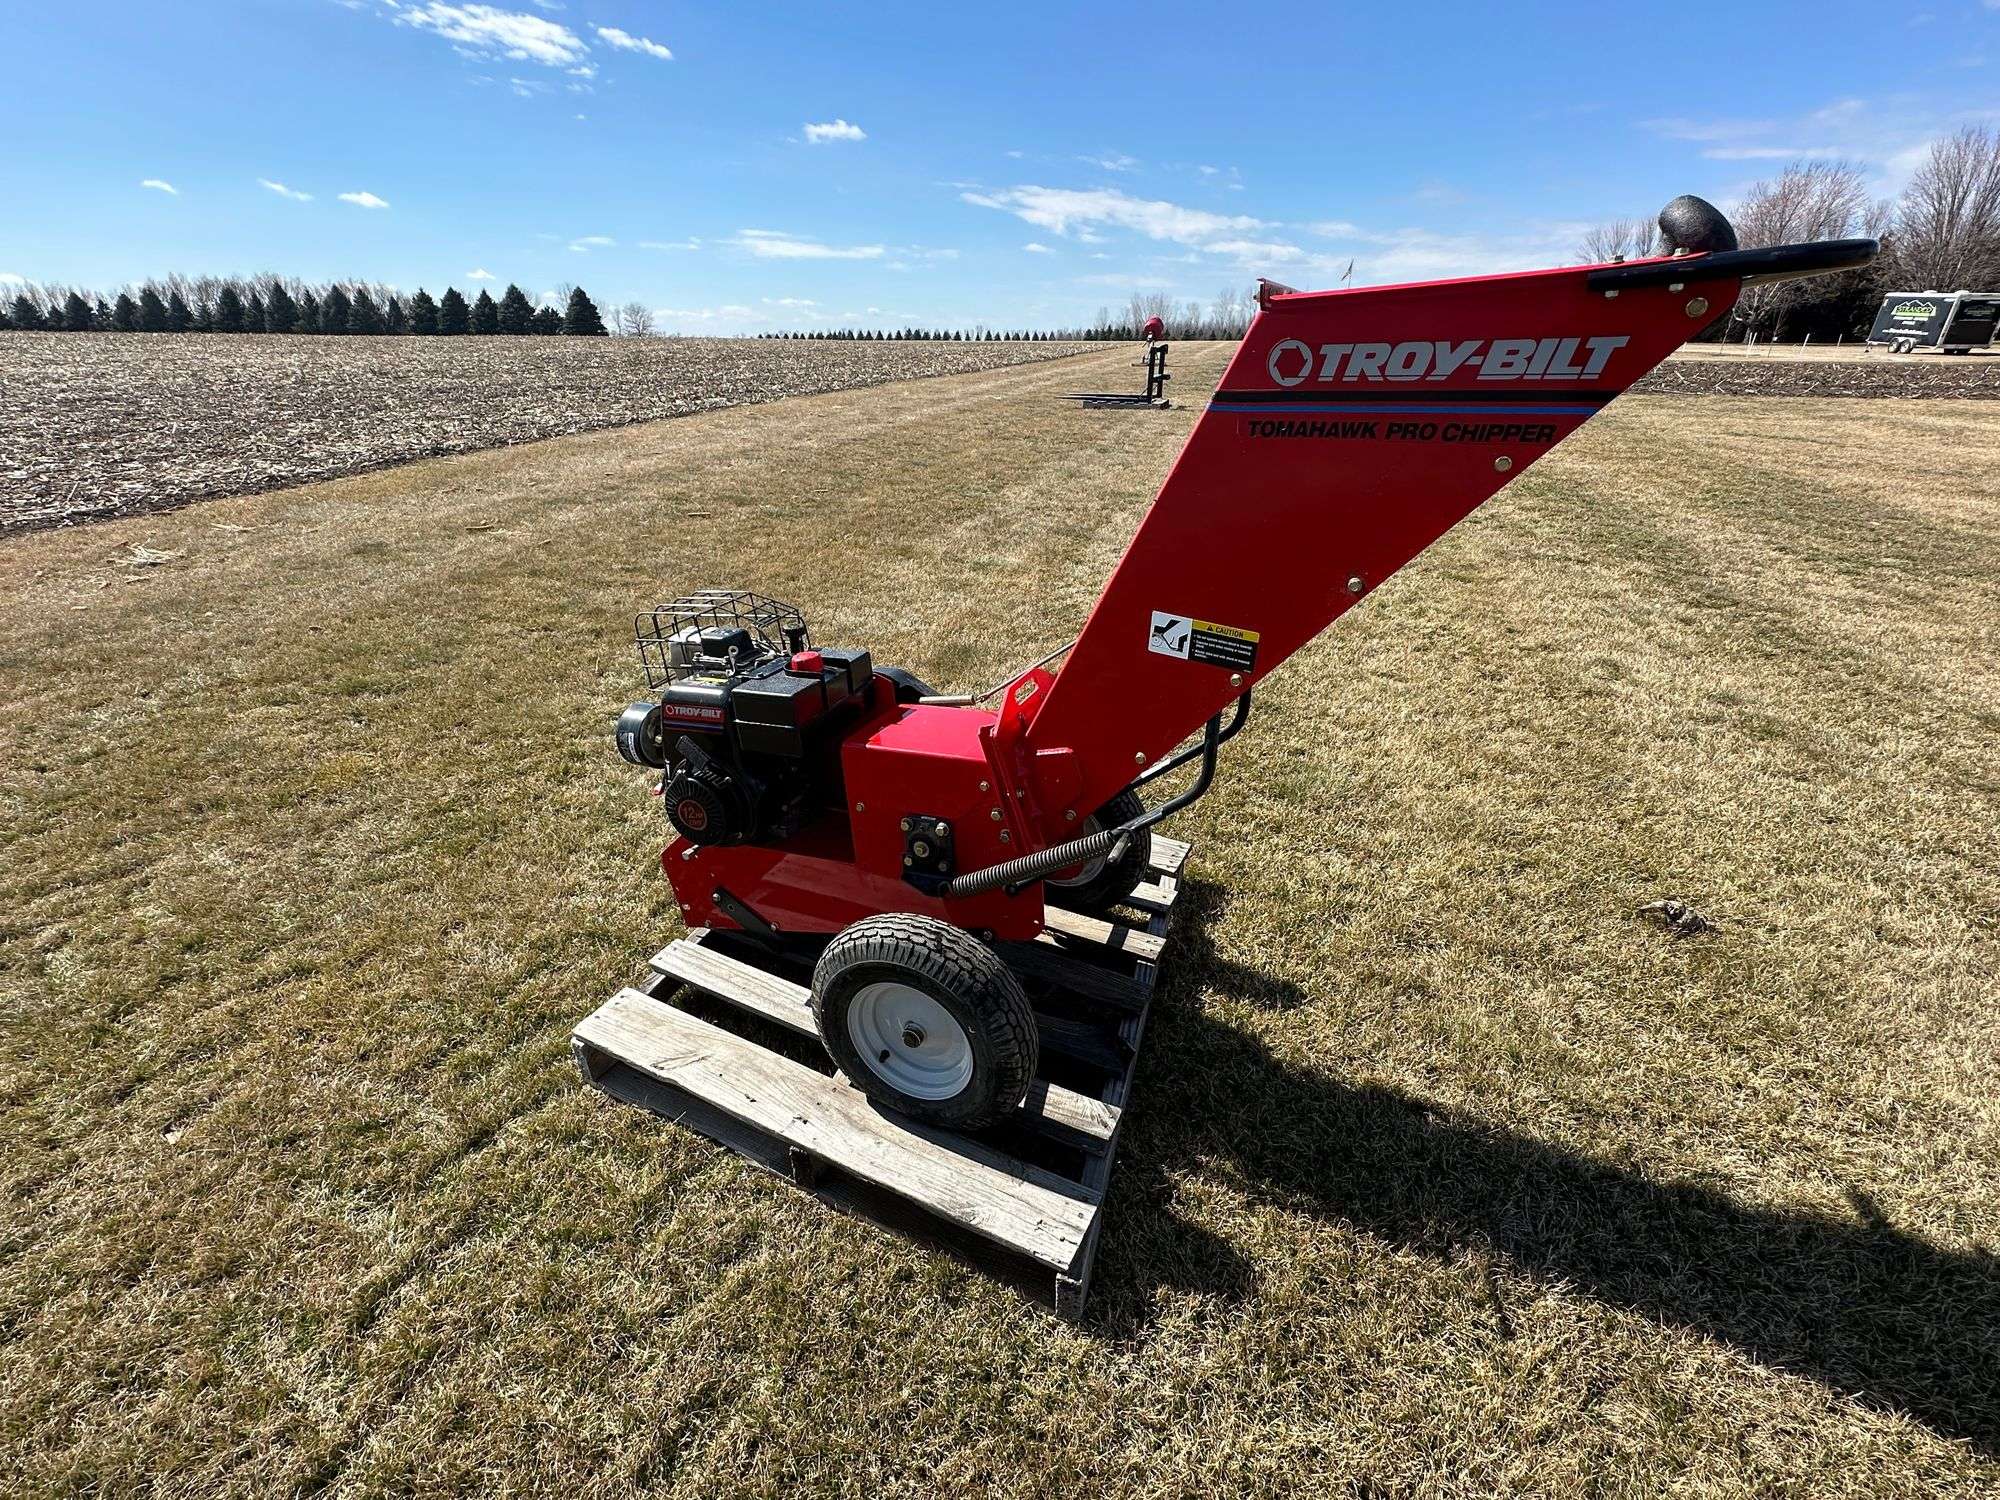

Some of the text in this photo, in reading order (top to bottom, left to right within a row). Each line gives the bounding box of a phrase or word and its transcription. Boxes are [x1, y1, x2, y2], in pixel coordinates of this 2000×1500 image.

[1317, 336, 1631, 381] TROY-BILT
[1248, 420, 1557, 442] TOMAHAWK PRO CHIPPER
[1215, 626, 1244, 638] CAUTION
[674, 706, 721, 718] TROY-BILT
